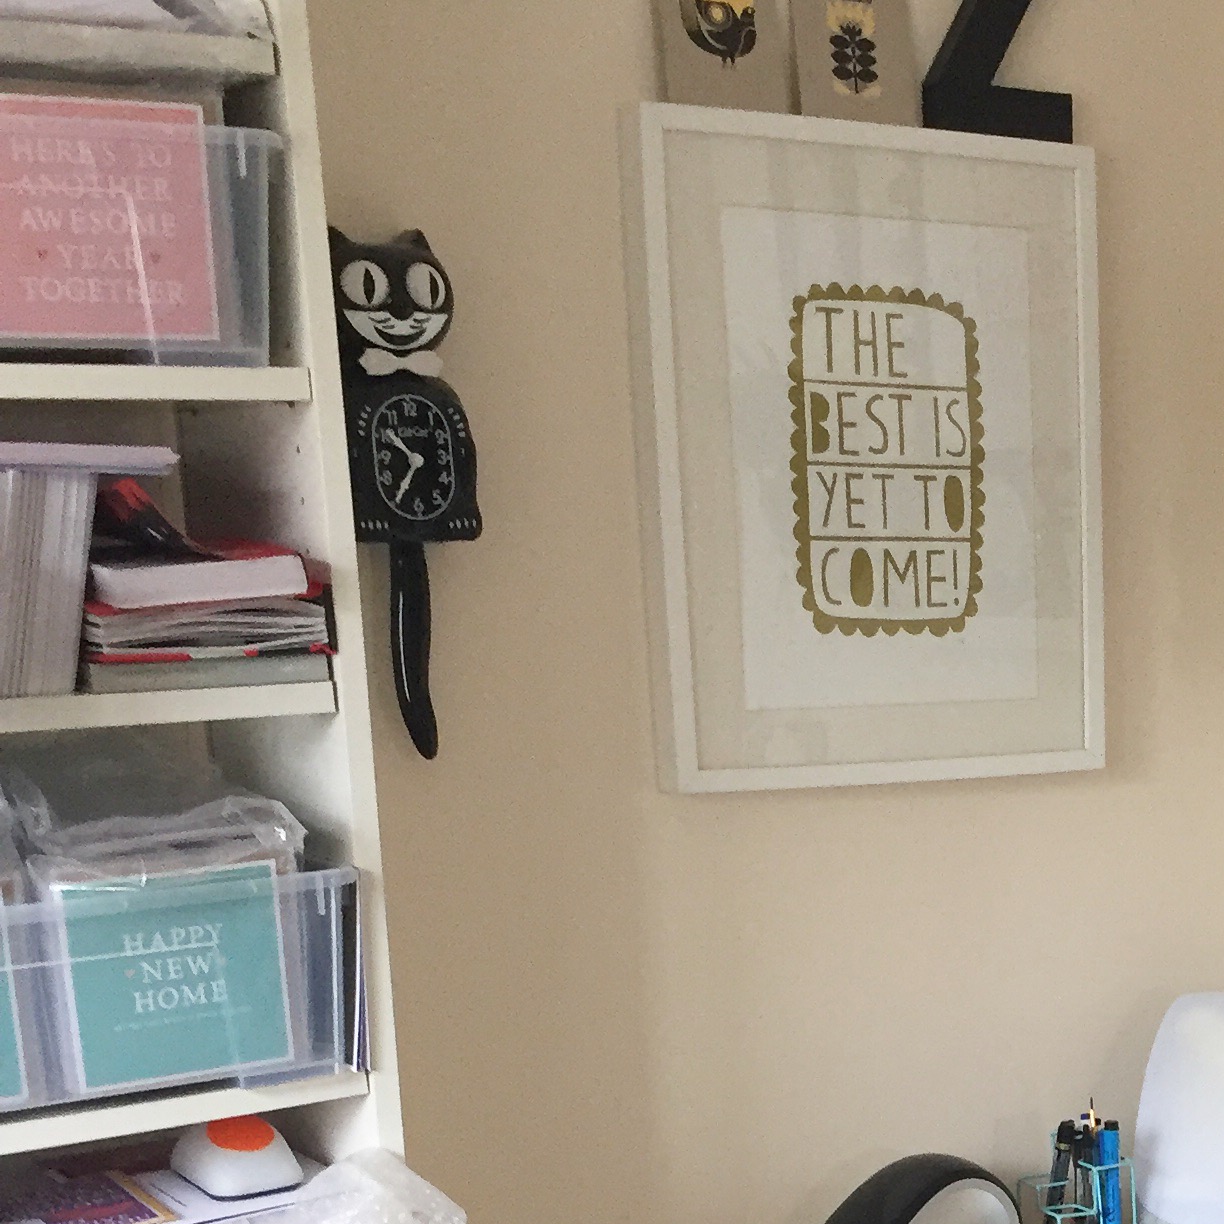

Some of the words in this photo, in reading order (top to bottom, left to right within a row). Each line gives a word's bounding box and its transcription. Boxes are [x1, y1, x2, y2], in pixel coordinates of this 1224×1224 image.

[20, 205, 176, 238] AWESOME
[815, 306, 909, 378] THE
[809, 390, 913, 456] BEST
[932, 396, 967, 457] IS
[815, 471, 895, 530] YET
[913, 475, 965, 533] TO
[820, 546, 960, 608] COME!
[122, 923, 224, 957] HAPPY
[139, 951, 214, 985] NEW
[132, 977, 229, 1015] HOME
